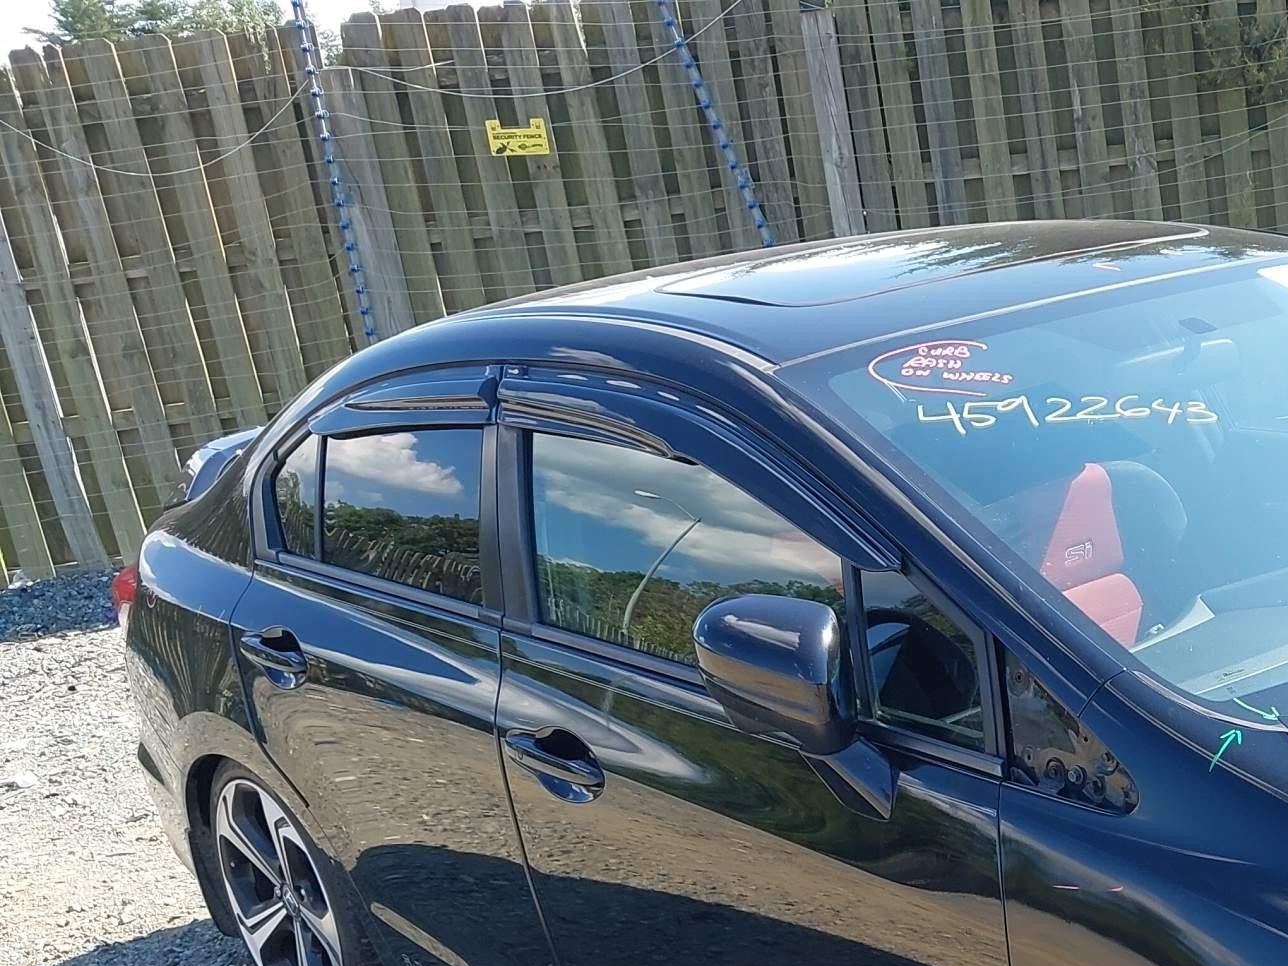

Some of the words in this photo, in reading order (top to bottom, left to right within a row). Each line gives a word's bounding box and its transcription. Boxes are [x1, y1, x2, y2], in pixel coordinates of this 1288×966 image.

[903, 356, 962, 369] RASH
[901, 368, 931, 377] ON
[942, 371, 1013, 384] WHEELS
[917, 395, 1218, 435] 45922643
